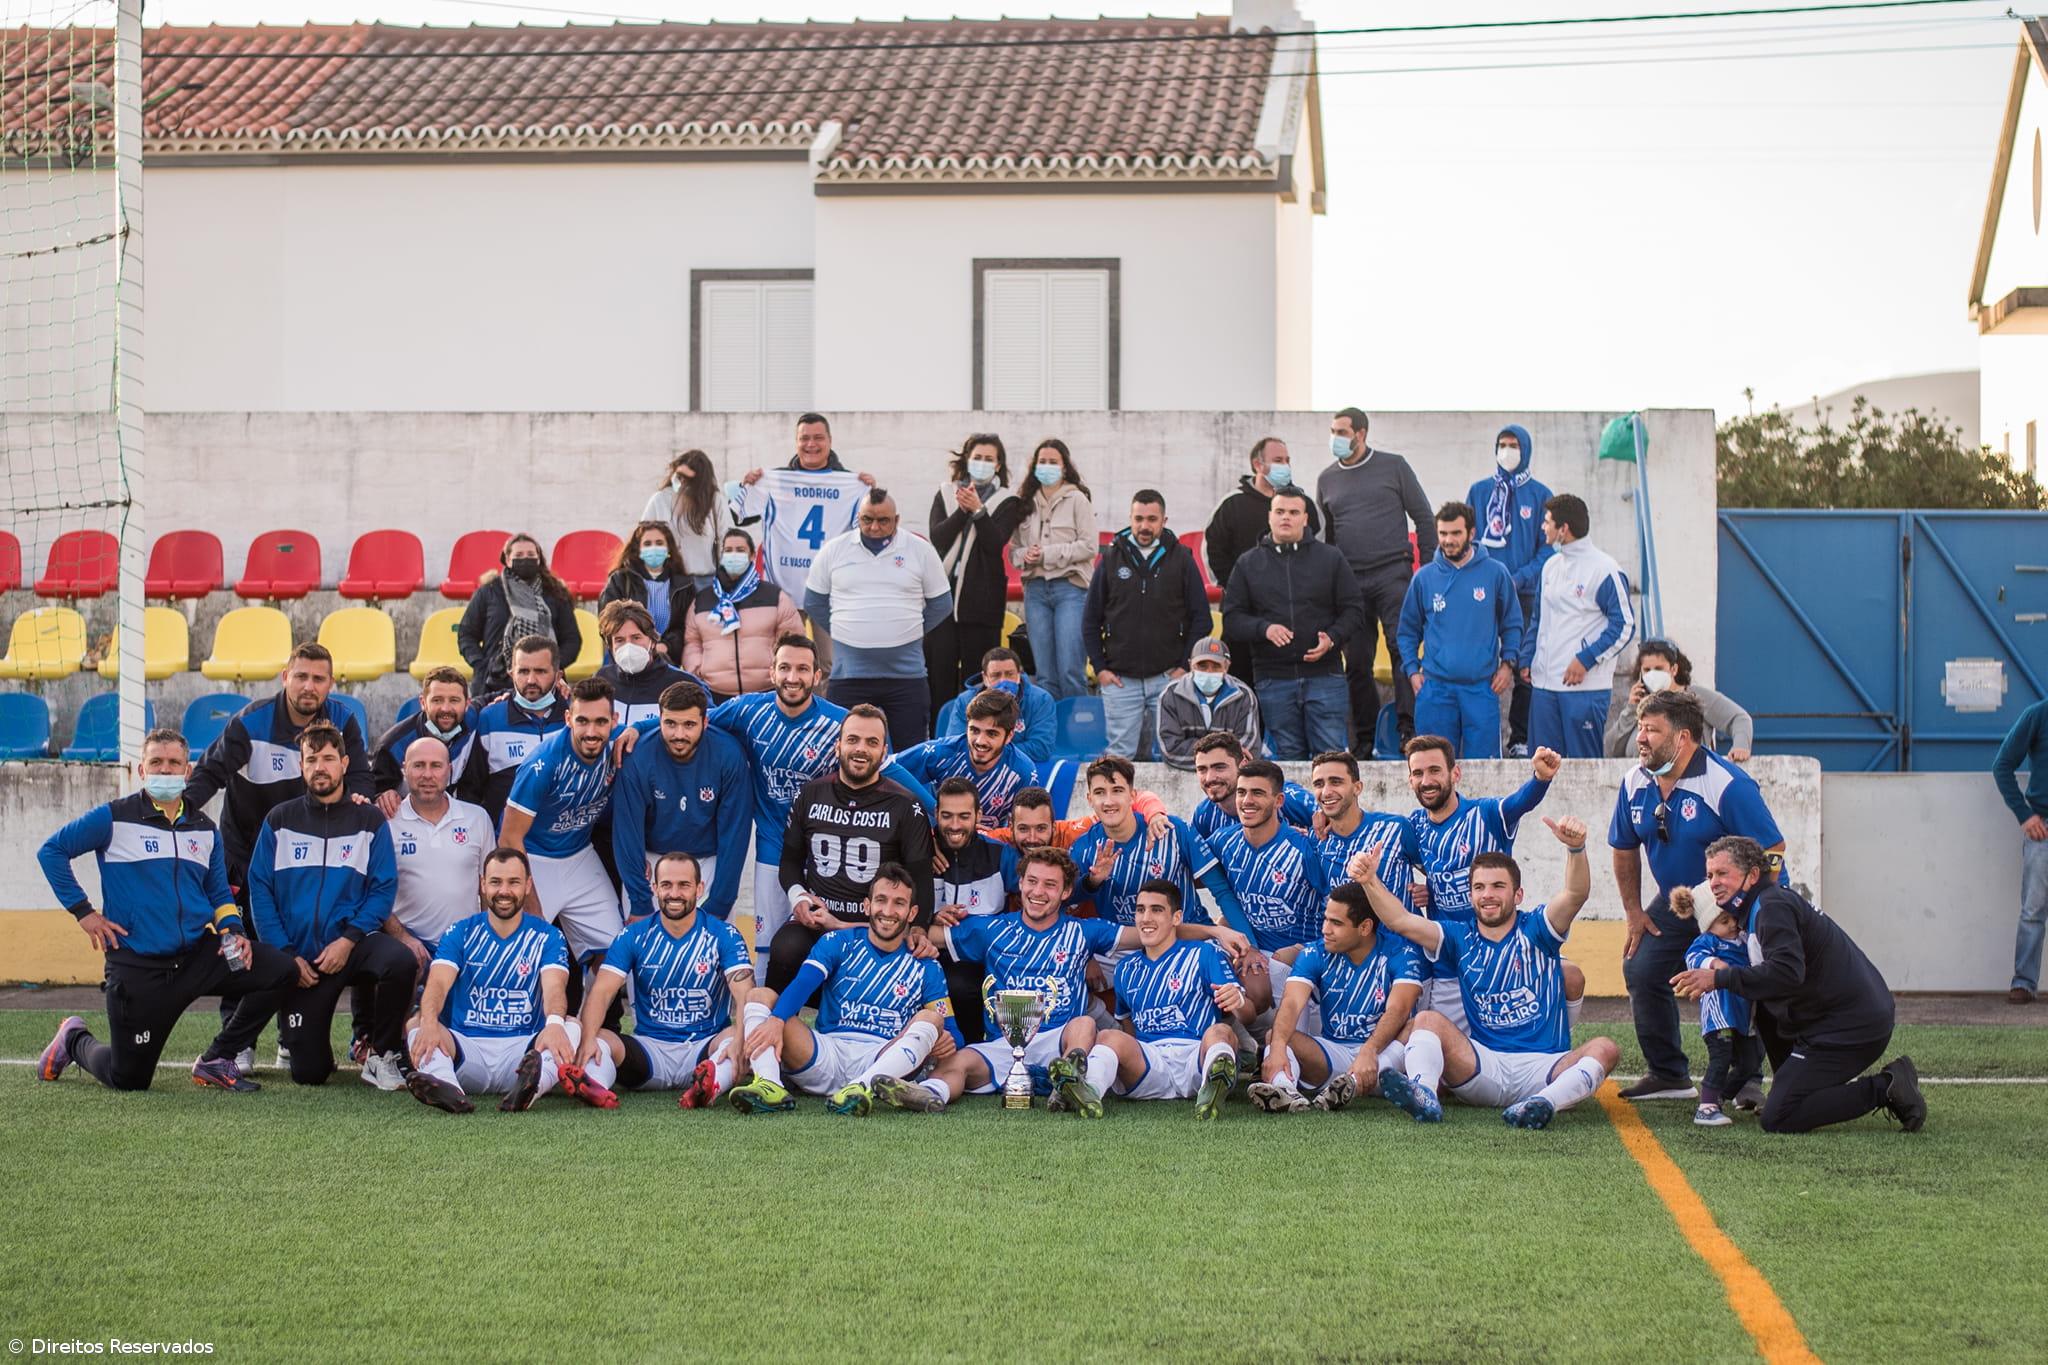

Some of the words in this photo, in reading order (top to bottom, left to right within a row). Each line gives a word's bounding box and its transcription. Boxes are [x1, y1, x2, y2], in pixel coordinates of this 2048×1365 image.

[794, 487, 840, 499] RODRIGO
[797, 505, 825, 550] 4
[790, 557, 811, 568] VASCO
[508, 744, 525, 758] MC
[272, 758, 284, 771] BS
[680, 796, 687, 811] 6
[808, 803, 851, 825] CARLOS
[852, 811, 890, 828] COSTA
[1631, 810, 1641, 824] CA
[145, 840, 159, 853] 69
[401, 843, 416, 855] AD
[294, 847, 308, 860] 87
[811, 833, 880, 883] 99
[1329, 877, 1352, 888] AUT
[1112, 894, 1137, 904] AUT
[846, 902, 858, 913] DO
[1113, 902, 1137, 916] VIL
[1005, 975, 1046, 988] AUTO
[470, 986, 508, 998] AUTO
[650, 988, 688, 999] AUTO
[1473, 992, 1511, 1005] AUTO
[470, 996, 506, 1013] VILA
[651, 996, 687, 1011] VILA
[840, 1001, 881, 1016] AUTO
[288, 1013, 303, 1028] 87
[466, 1009, 533, 1026] PINHEIRO
